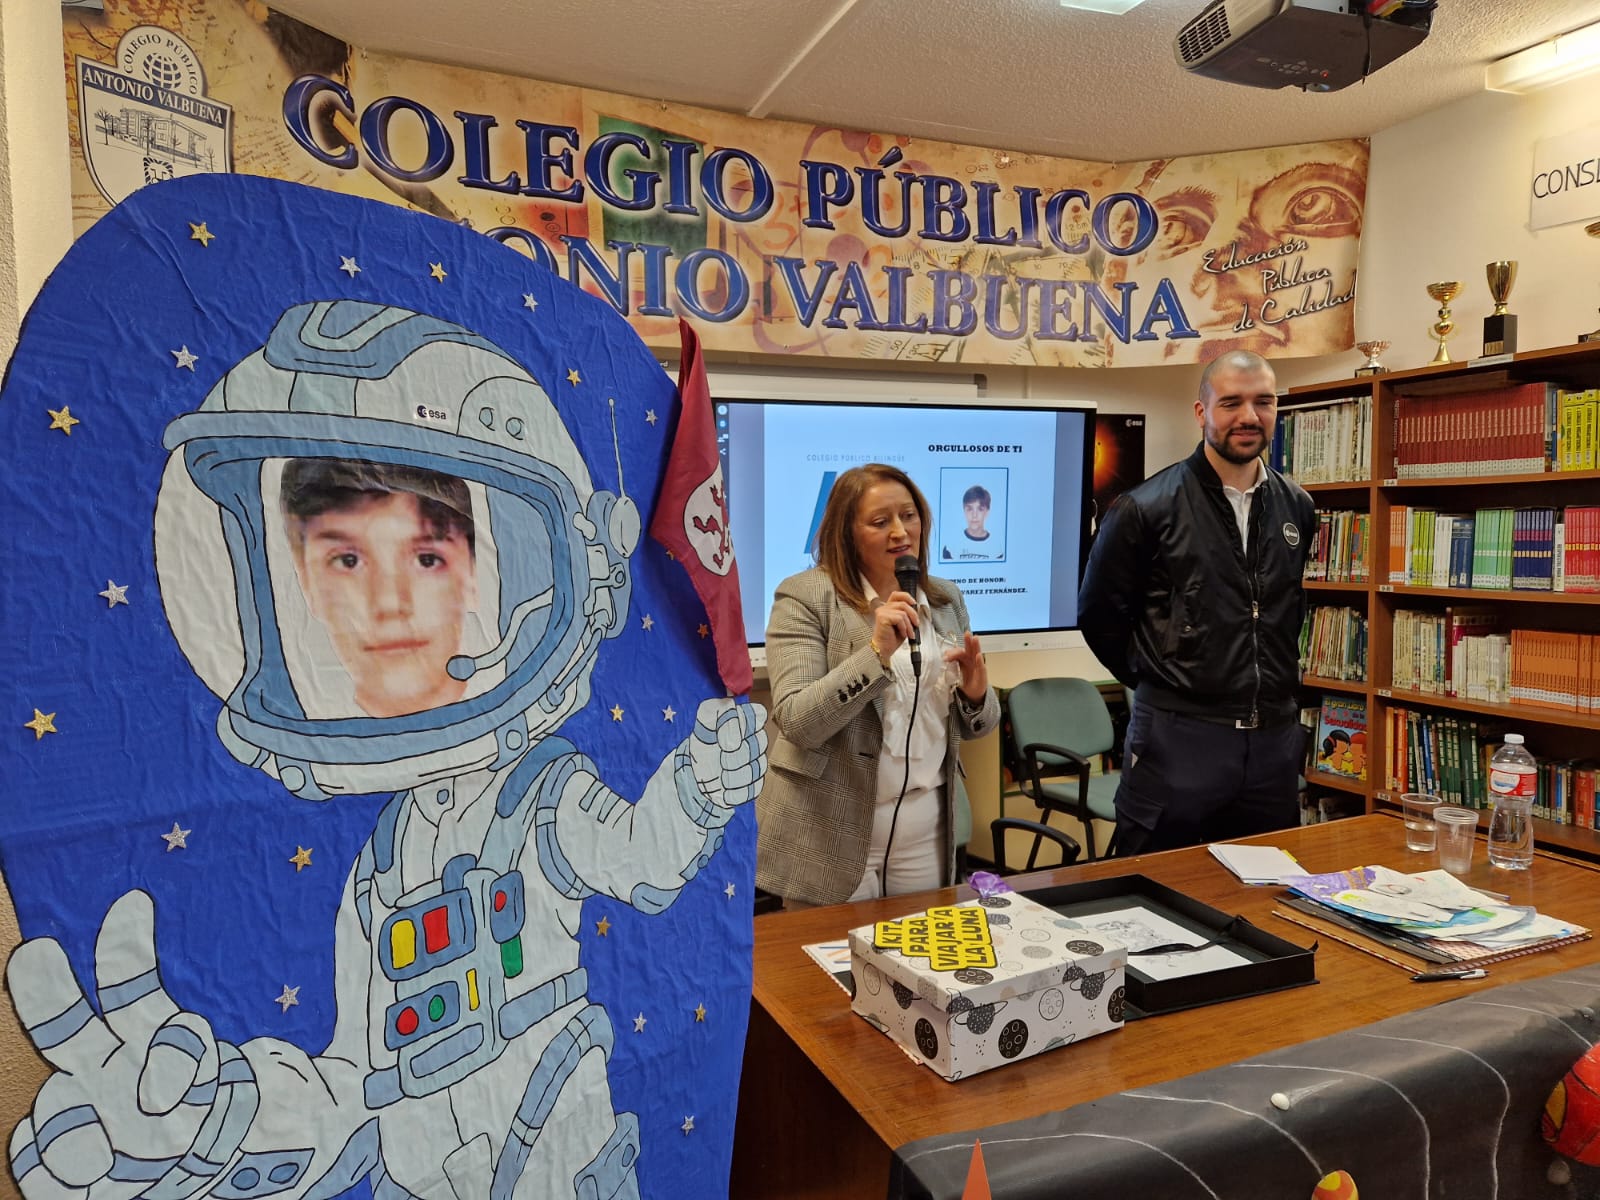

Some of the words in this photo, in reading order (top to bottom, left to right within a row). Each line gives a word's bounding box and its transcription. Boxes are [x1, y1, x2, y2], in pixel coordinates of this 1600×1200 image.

[124, 34, 161, 74] COLEGIO
[166, 39, 198, 95] PÚBLICO
[84, 67, 154, 101] ANTONIO
[157, 89, 223, 125] VALBUENA
[282, 73, 775, 223] COLEGIO
[799, 145, 1159, 257] PÚBLICO
[1202, 238, 1308, 274] Educación
[460, 218, 750, 323] ONIO
[773, 255, 1202, 344] VALBUENA
[1261, 256, 1331, 295] Pública
[1233, 303, 1255, 333] de
[1260, 268, 1358, 325] Calidad
[429, 409, 447, 420] esa
[928, 444, 994, 453] ORGULLOSOS
[997, 445, 1010, 453] DE
[1012, 445, 1023, 453] TI
[934, 909, 953, 917] A
[960, 909, 983, 942] LUNA
[882, 925, 903, 944] KIT
[909, 919, 929, 954] PARA
[935, 921, 962, 966] VIAJAR
[965, 947, 987, 964] LA
